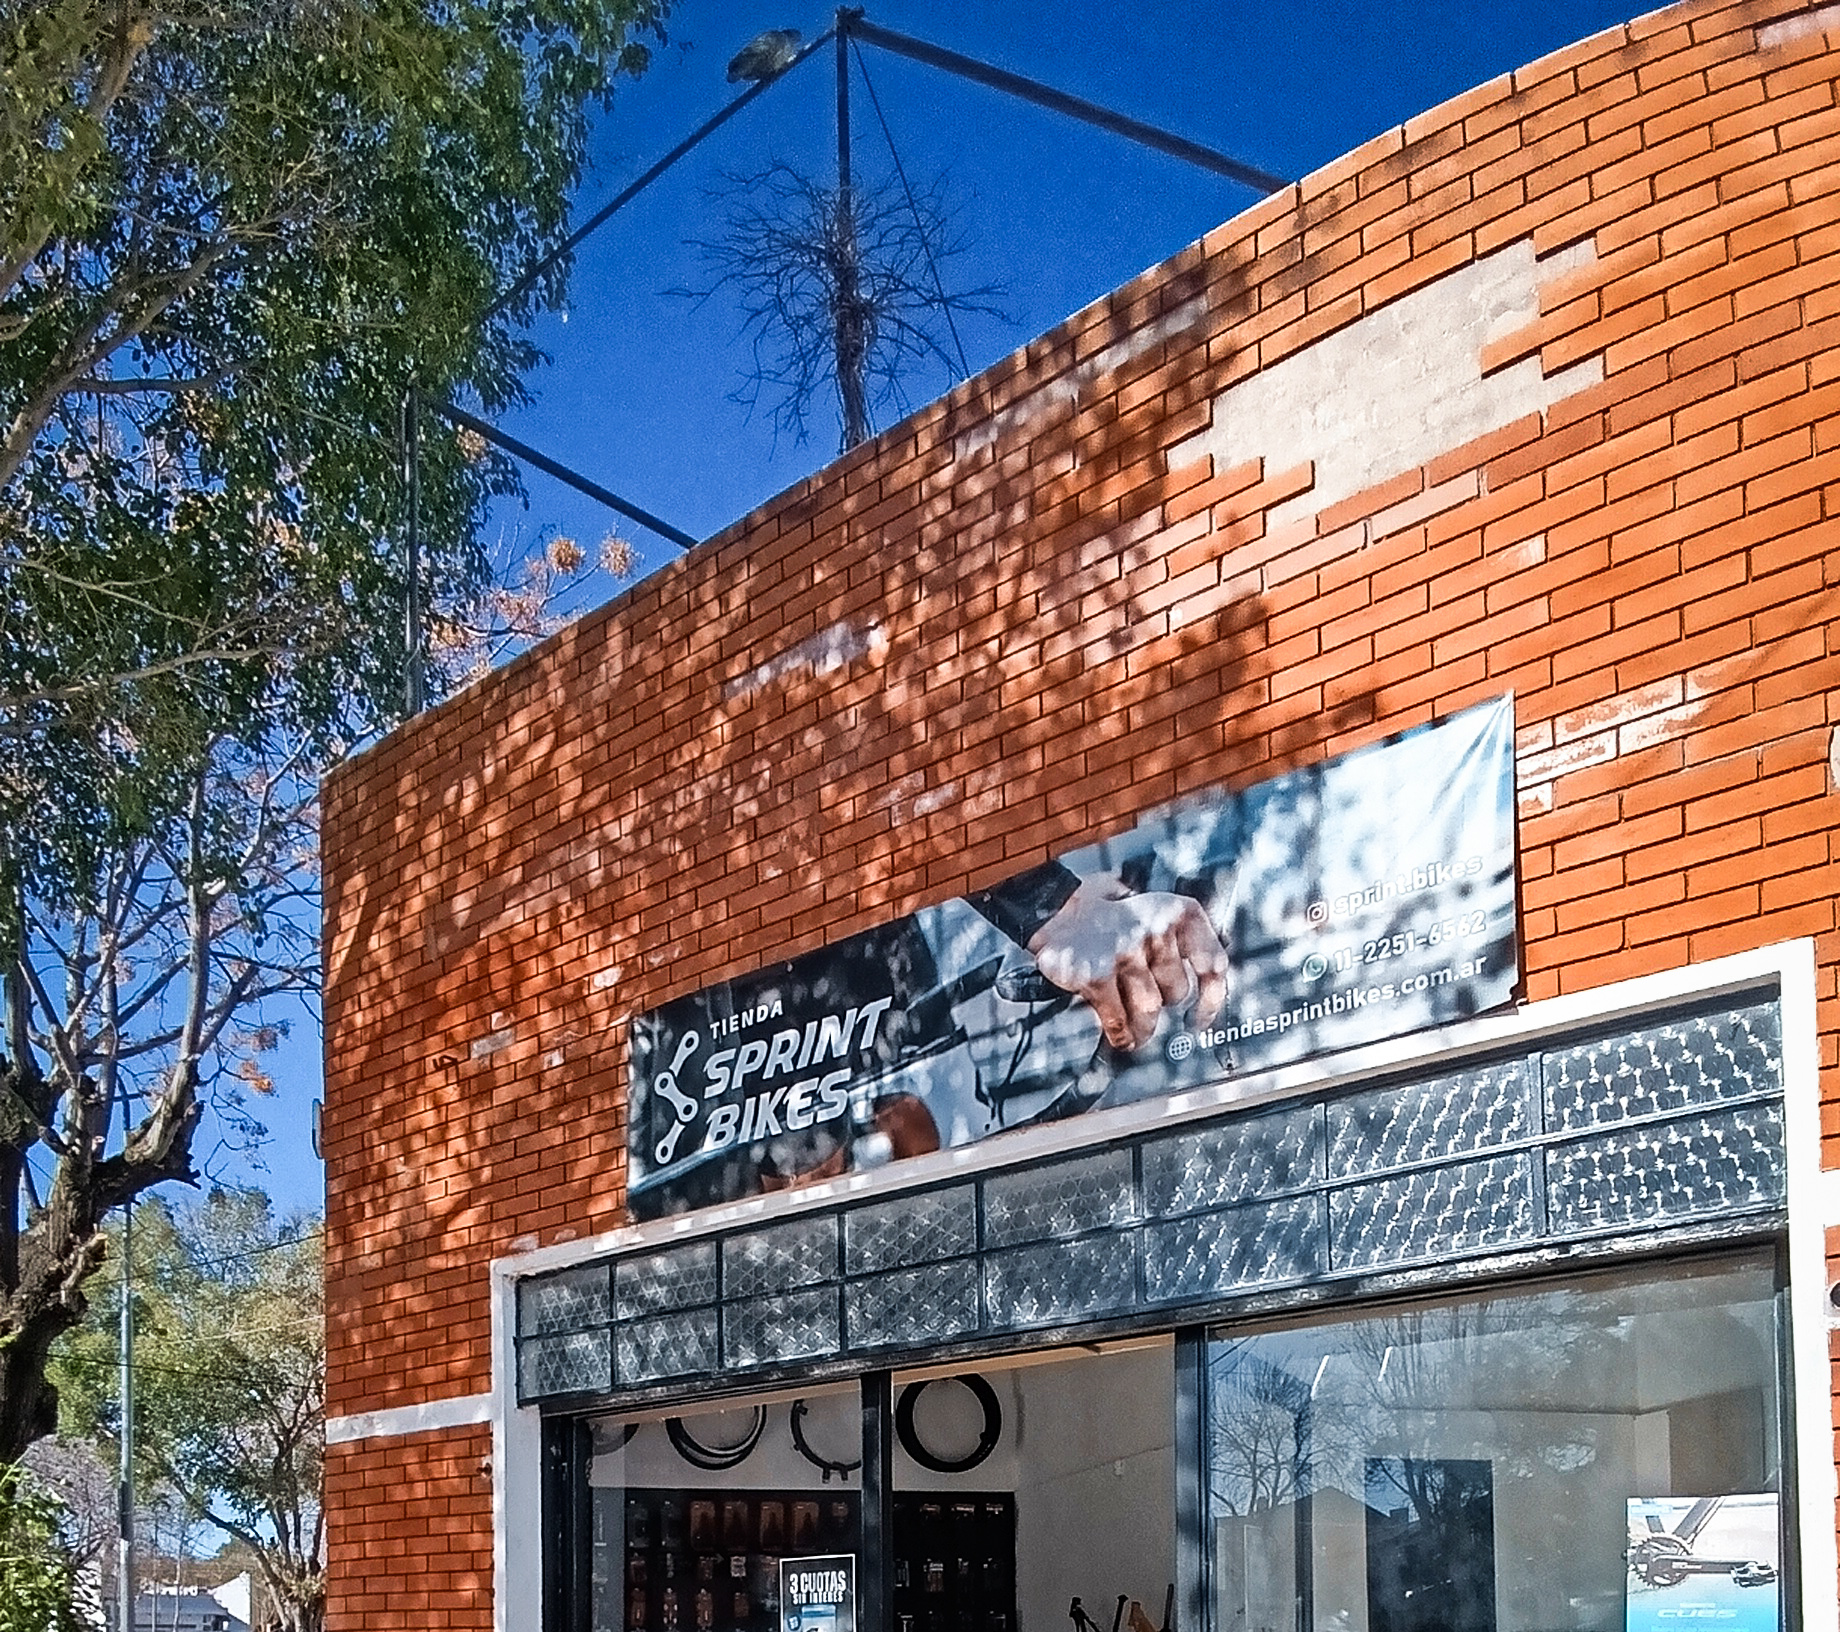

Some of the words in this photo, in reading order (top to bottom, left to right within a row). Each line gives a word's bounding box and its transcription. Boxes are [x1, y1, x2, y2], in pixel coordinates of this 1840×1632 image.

[1334, 856, 1483, 916] sprint.bikes
[1333, 910, 1486, 972] 11-2251-6562
[710, 1000, 783, 1039] TIENDA
[1199, 955, 1487, 1050] tiendasprintbikes.com.ar
[703, 996, 893, 1099] SPRINT
[703, 1068, 852, 1151] BIKES
[789, 1573, 799, 1594] 3
[800, 1570, 847, 1593] CUOTAS
